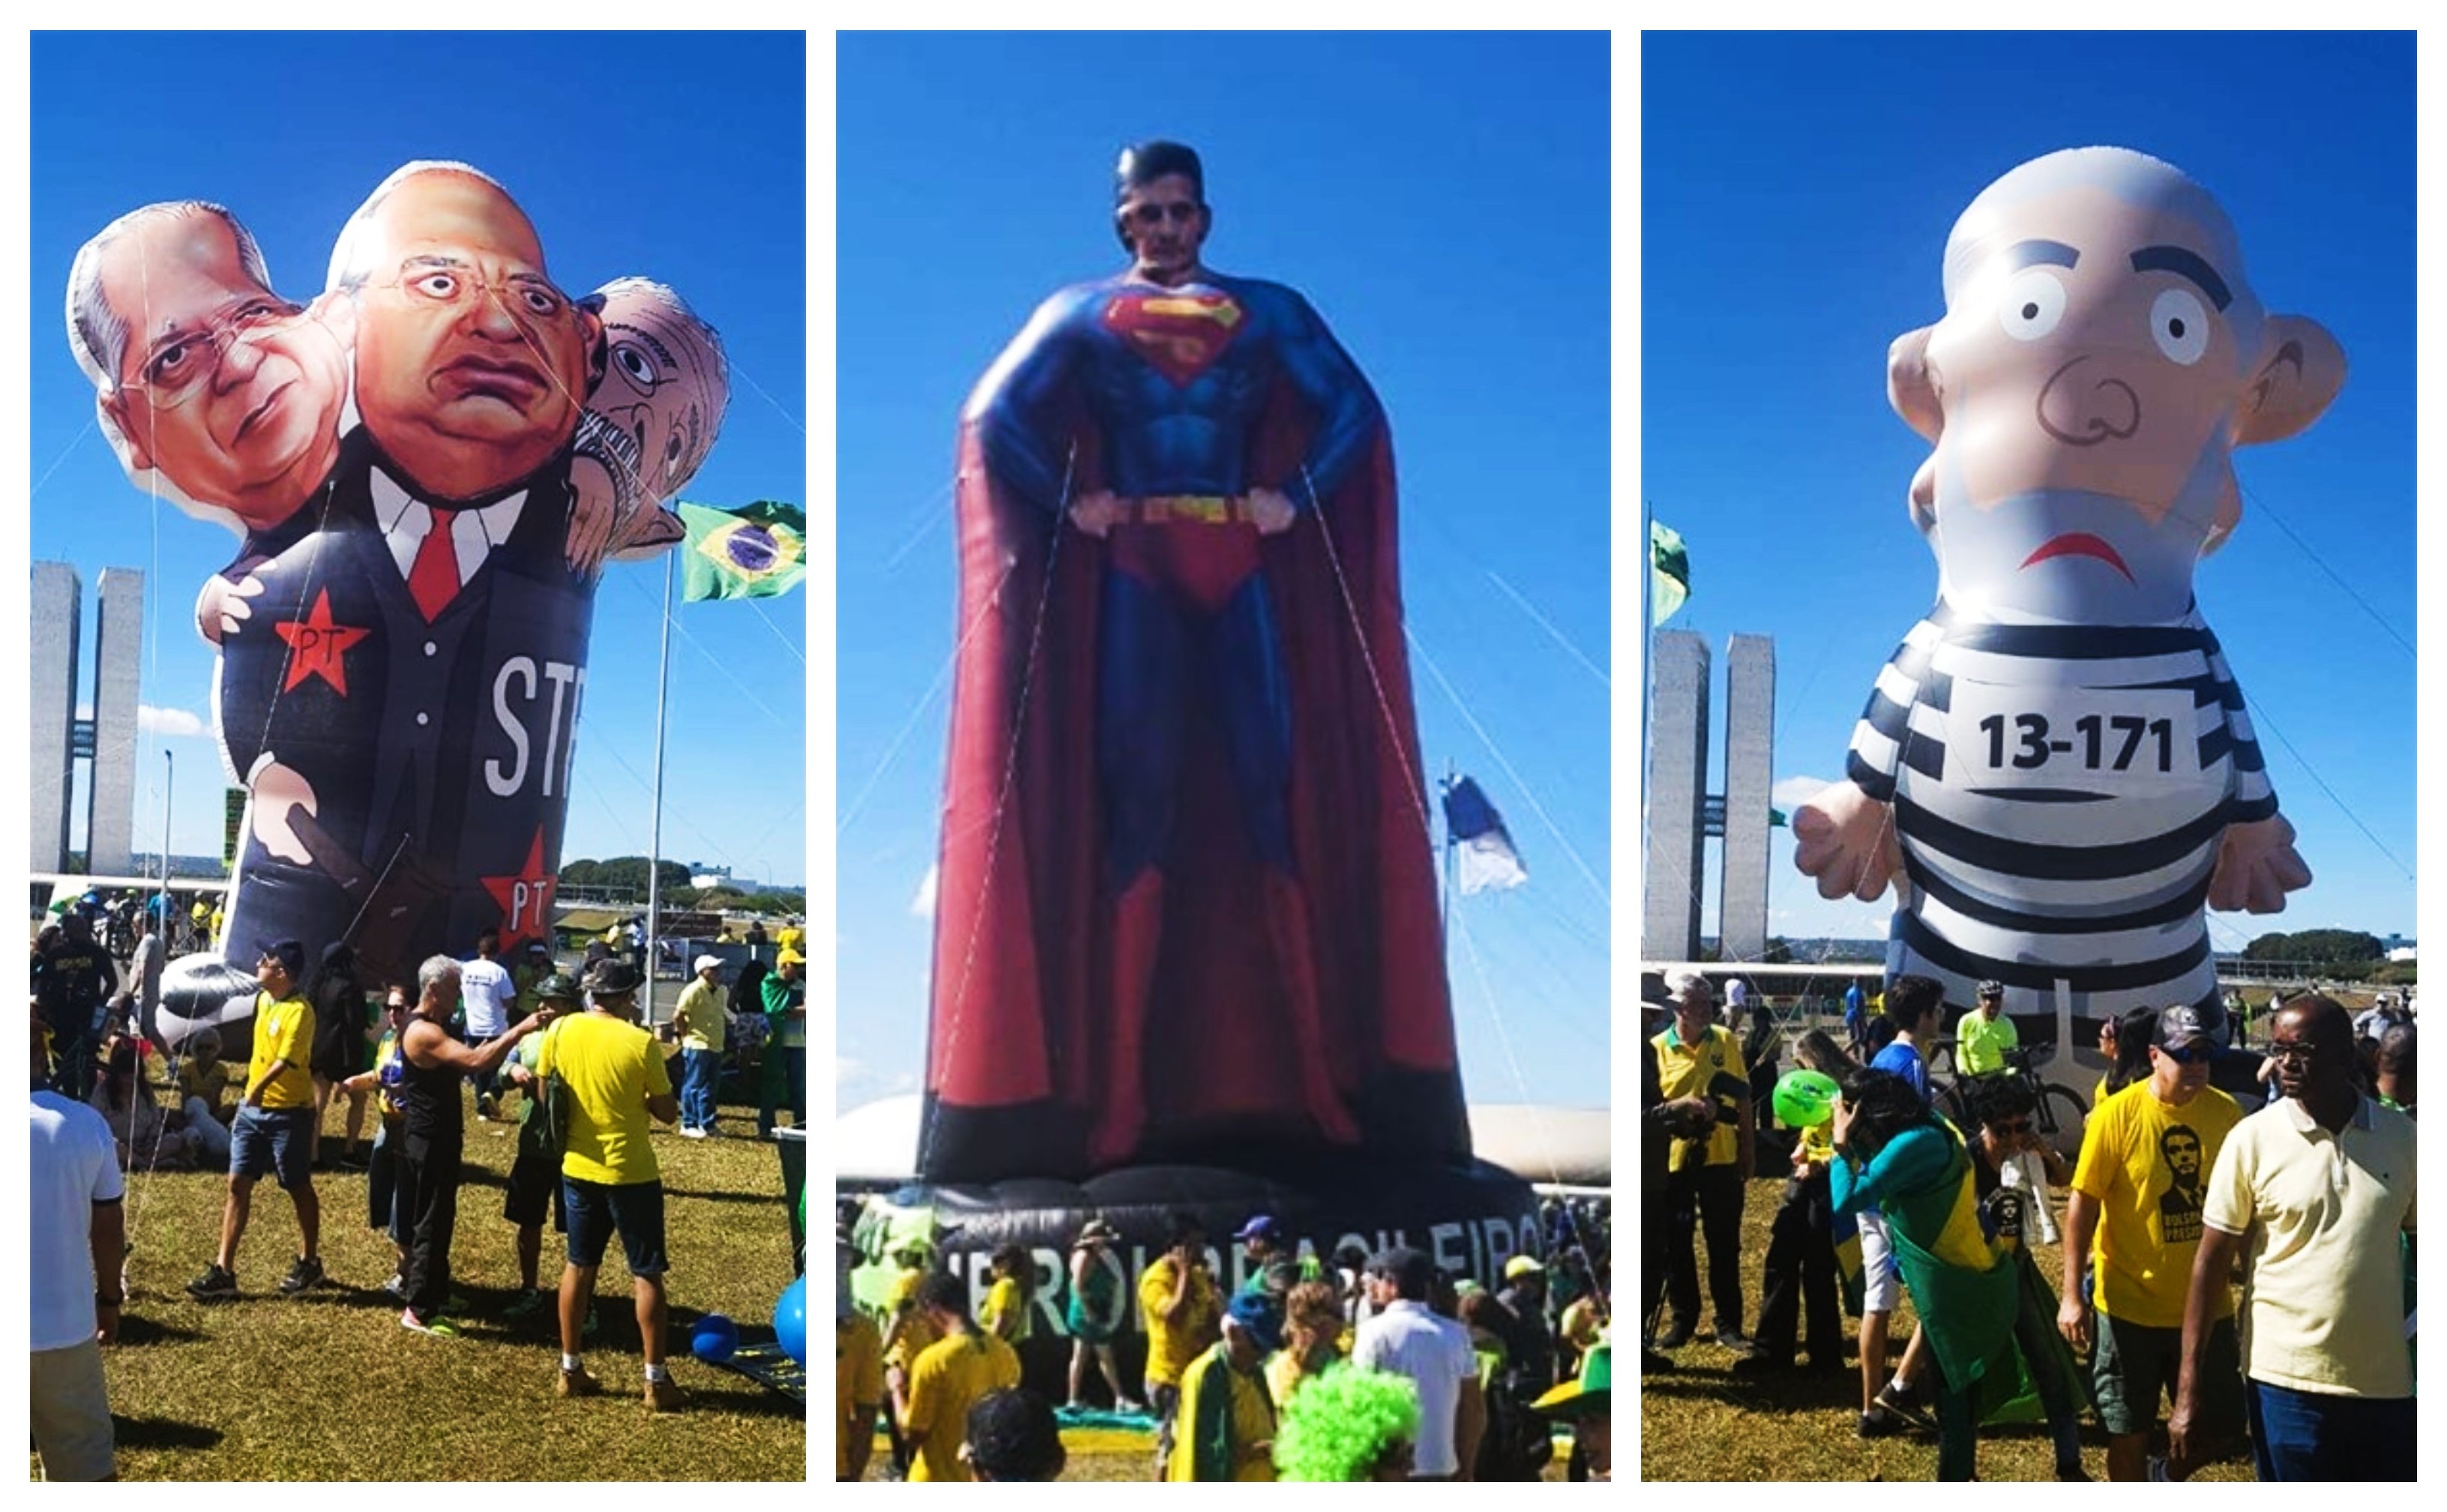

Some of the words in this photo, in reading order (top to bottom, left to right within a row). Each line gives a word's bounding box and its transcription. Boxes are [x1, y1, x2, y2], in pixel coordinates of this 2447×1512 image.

[299, 627, 347, 668] PT
[1980, 713, 2172, 773] 13-171
[511, 881, 548, 931] PT
